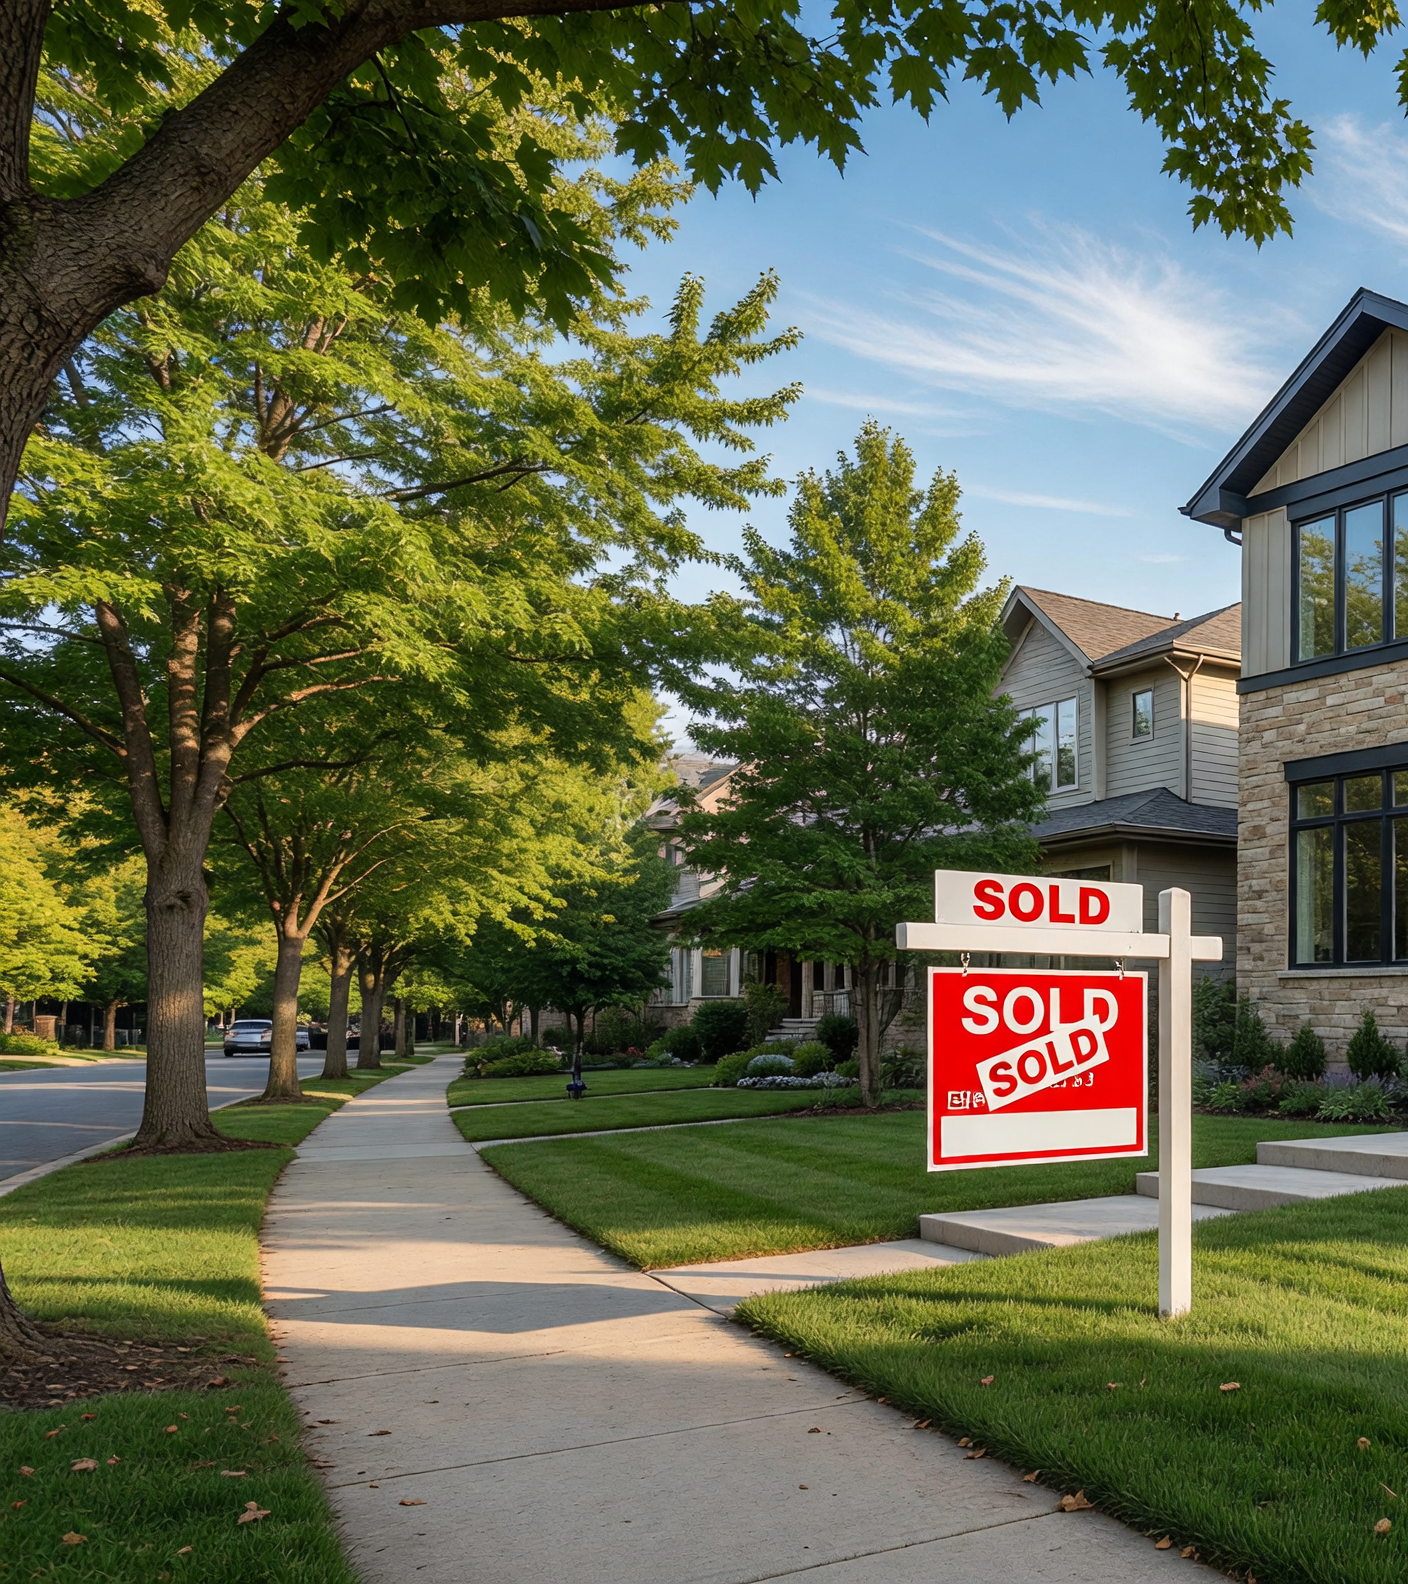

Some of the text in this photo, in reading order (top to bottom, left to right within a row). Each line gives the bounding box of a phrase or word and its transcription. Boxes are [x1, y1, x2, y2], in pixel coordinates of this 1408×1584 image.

[973, 879, 1110, 925] SOLD
[961, 985, 1119, 1035] SOLD
[988, 1028, 1099, 1098] SOLD
